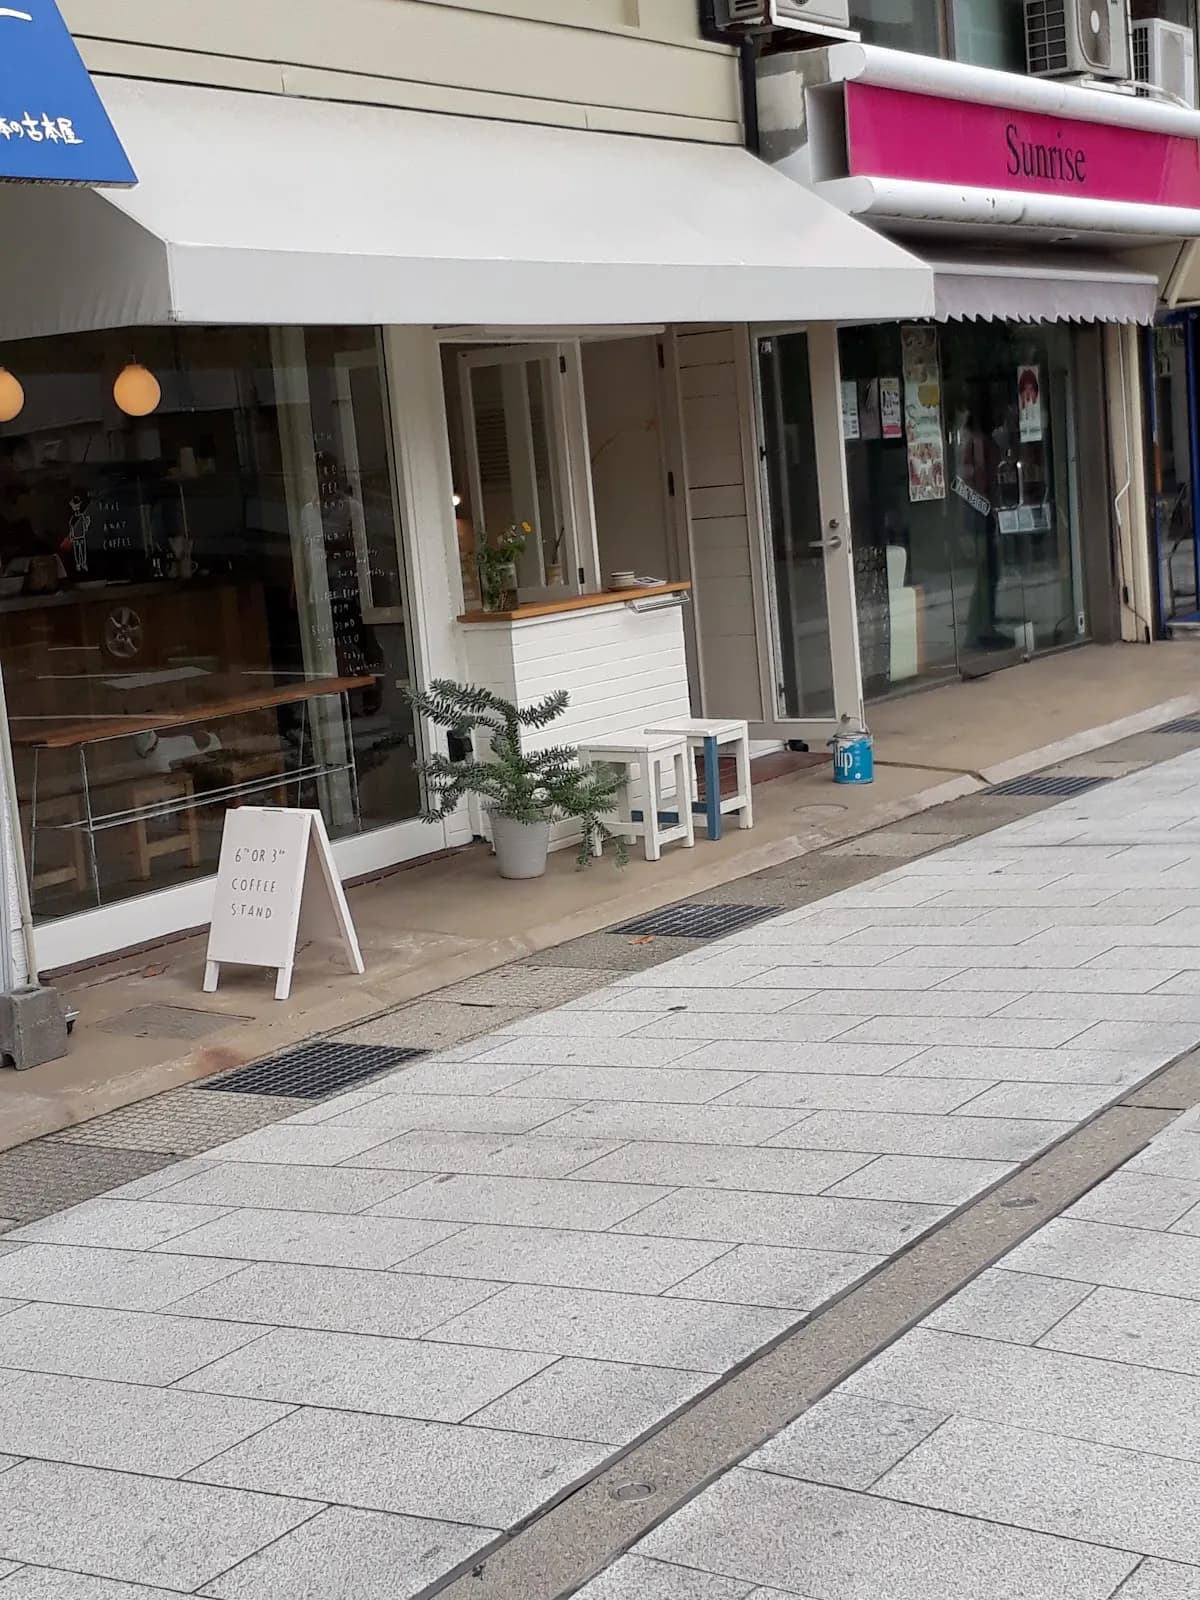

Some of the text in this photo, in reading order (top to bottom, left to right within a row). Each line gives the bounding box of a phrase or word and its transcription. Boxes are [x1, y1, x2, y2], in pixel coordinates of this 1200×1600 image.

[1006, 124, 1086, 182] Sunrise
[252, 849, 265, 862] OR
[231, 878, 276, 892] COFFEE
[231, 903, 272, 919] STAND
